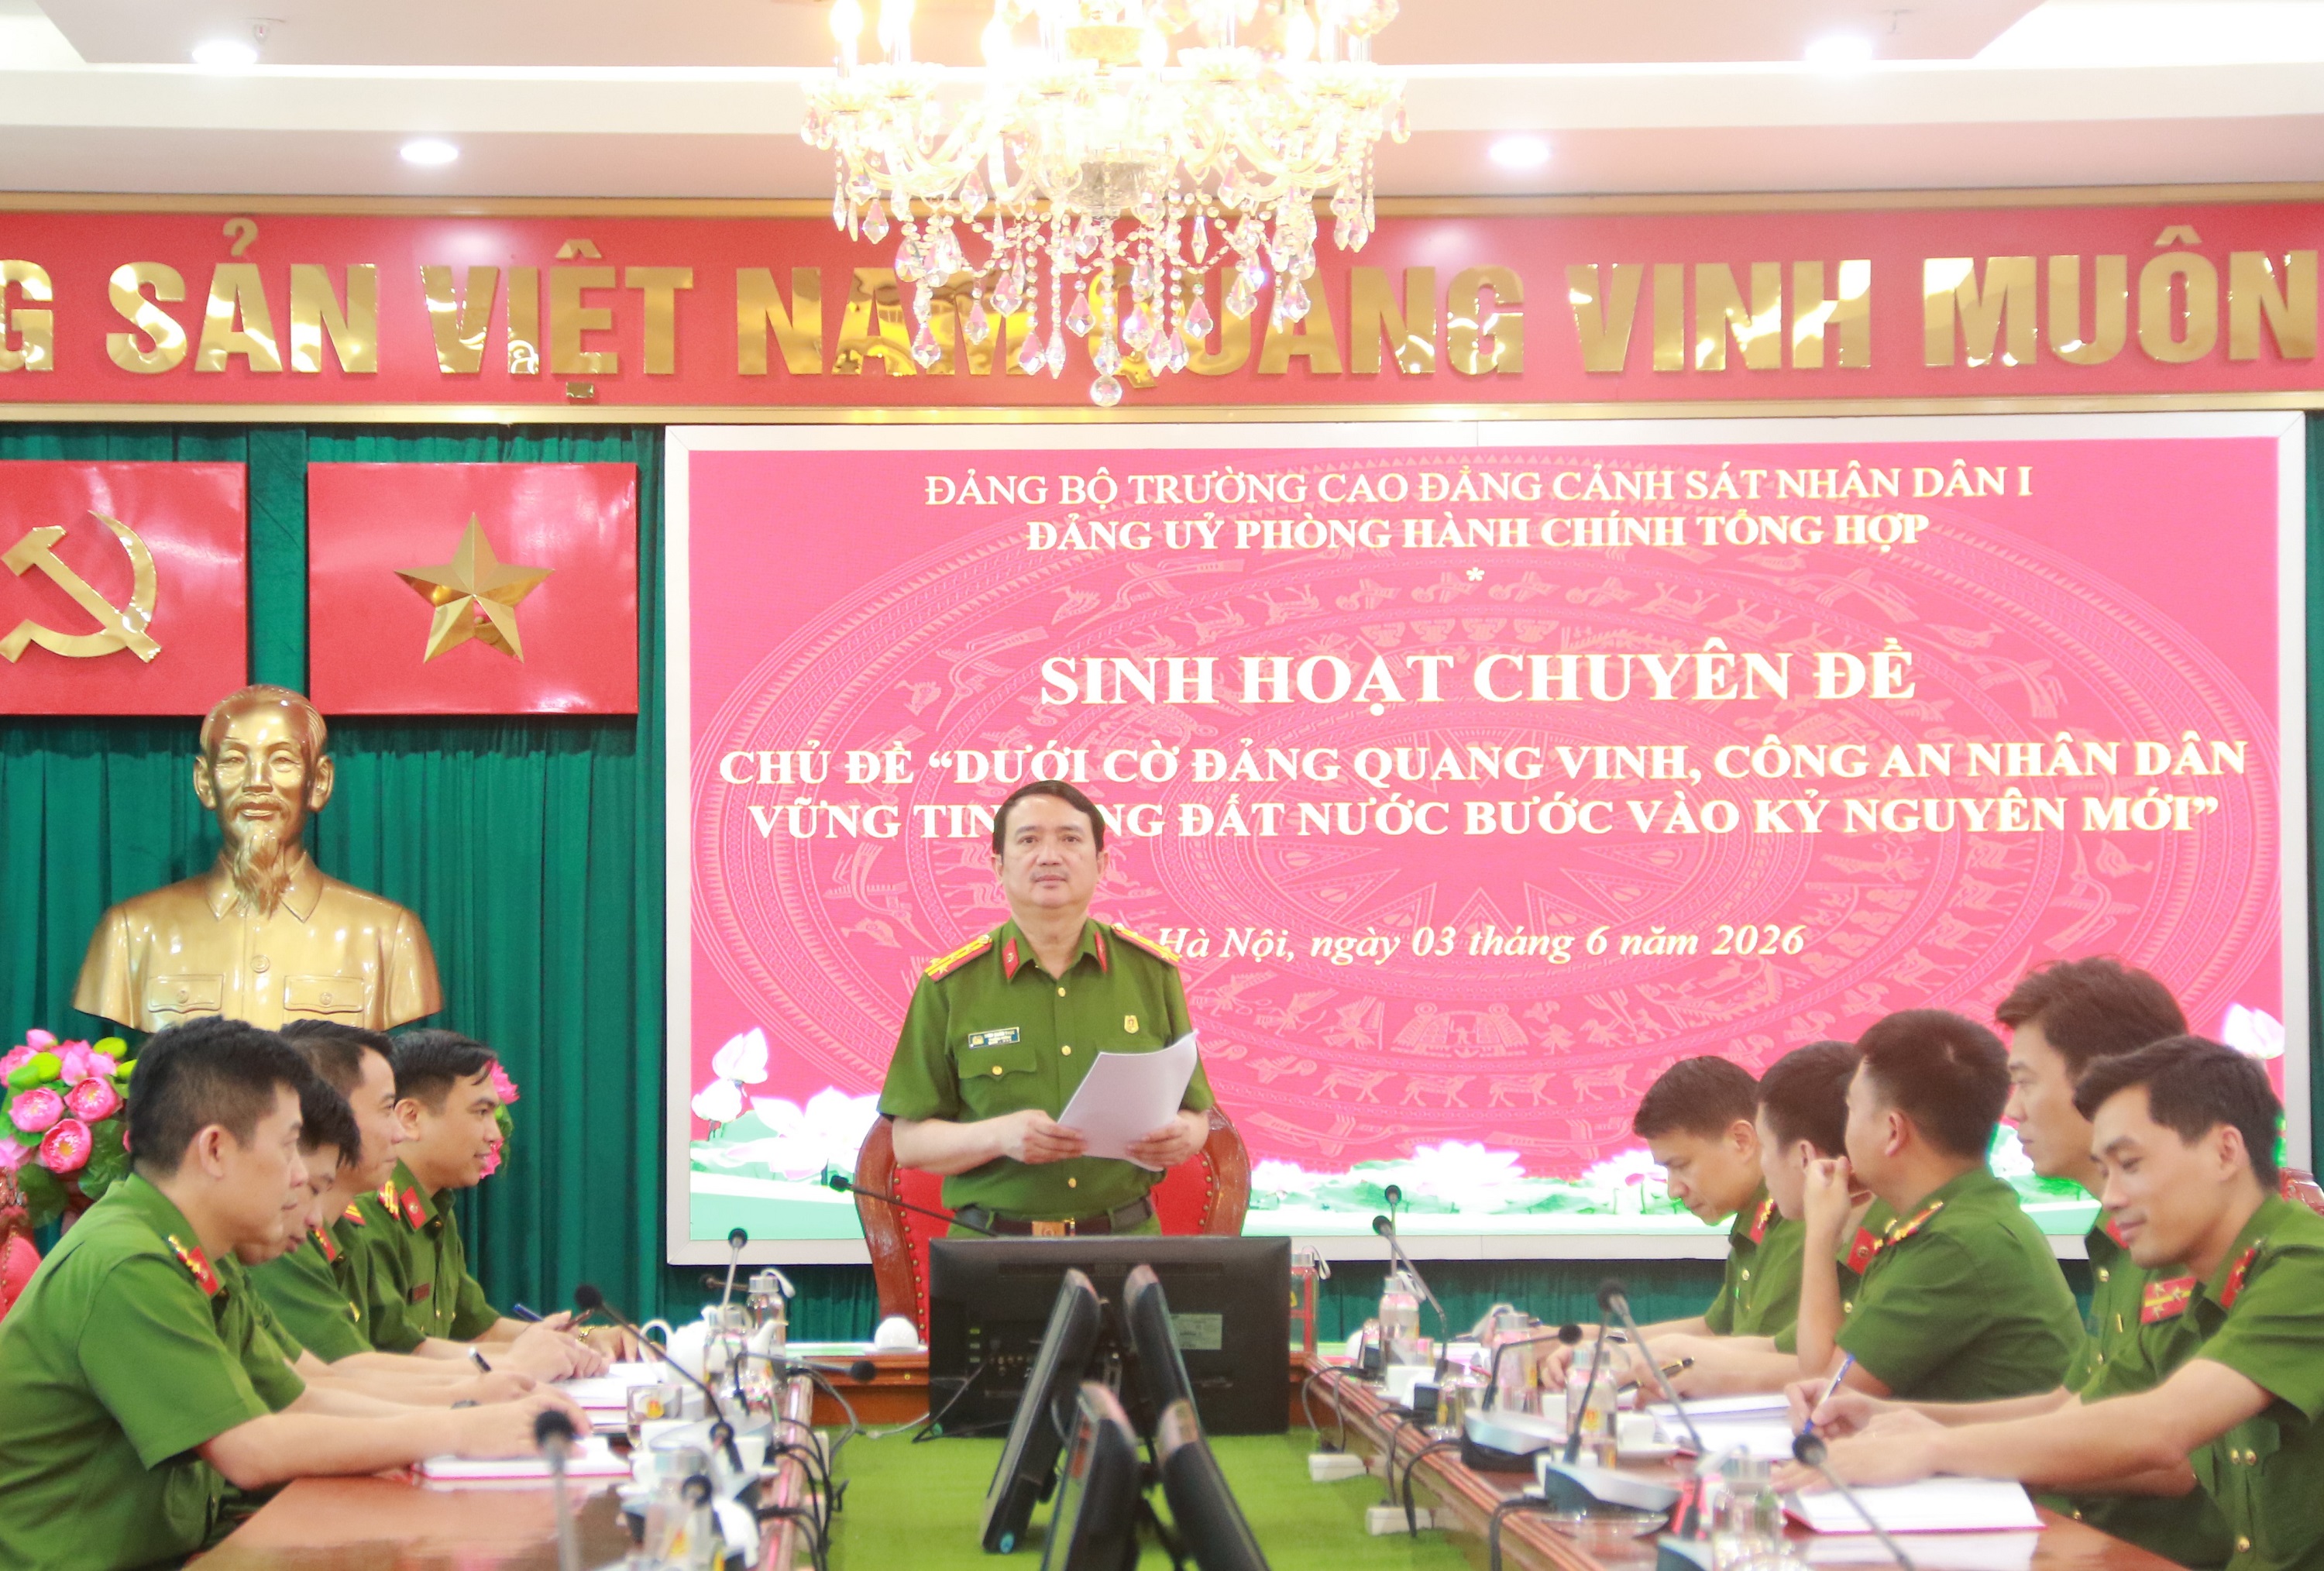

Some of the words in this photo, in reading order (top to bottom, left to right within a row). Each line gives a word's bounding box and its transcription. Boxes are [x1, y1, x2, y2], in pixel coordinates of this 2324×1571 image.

[106, 218, 379, 375] SẢN
[421, 239, 694, 399] VIỆT
[736, 266, 1033, 377] NAM
[1566, 259, 1872, 372] VINH
[1923, 224, 2319, 369] MUÔN
[925, 468, 1049, 505] ĐẢNG
[1058, 466, 1118, 510] BỘ
[1127, 466, 1308, 504] TRƯỜNG
[1318, 473, 1408, 503] CAO
[1418, 465, 1543, 502] ĐẲNG
[1552, 463, 1675, 501] CẢNH
[1686, 461, 1767, 500] SÁT
[1775, 460, 1901, 498] NHÂN
[1913, 459, 2007, 497] DÂN
[2018, 466, 2033, 496] I
[1026, 512, 1152, 551] ĐẢNG
[1163, 511, 1224, 550] UỶ
[1234, 512, 1392, 549] PHÒNG
[1401, 511, 1531, 548] HÀNH
[1540, 510, 1686, 548] CHÍNH
[1834, 512, 1930, 553] HỢP
[1040, 655, 1219, 705] SINH
[1237, 655, 1454, 717] HOẠT
[1473, 637, 1793, 703] CHUYÊN
[1813, 637, 1916, 700] ĐỀ
[720, 740, 830, 784] CHỦ
[844, 741, 913, 783] ĐỀ
[929, 742, 1090, 782] “DƯỚI
[1102, 741, 1180, 782] CỜ
[1191, 737, 1342, 782] ĐẢNG
[1353, 747, 1544, 789] QUANG
[1556, 745, 1702, 785] VINH,
[1714, 734, 1869, 779] CÔNG
[1879, 742, 1954, 777] AN
[1966, 731, 2120, 776] NHÂN
[2133, 730, 2248, 775] DÂN
[748, 797, 901, 839] VỮNG
[1177, 792, 1285, 837] ĐẤT
[1297, 792, 1449, 837] NƯỚC
[1463, 792, 1613, 835] BƯỚC
[1627, 791, 1740, 834] VÀO
[1753, 787, 1830, 833] KỶ
[1843, 787, 2068, 832] NGUYÊN
[2082, 786, 2219, 831] MỚI”
[1159, 927, 1209, 958] Hà
[1219, 927, 1294, 962] Nội,
[1310, 927, 1401, 965] ngày
[1412, 926, 1456, 956] 03
[1469, 925, 1576, 964] tháng
[1586, 925, 1611, 955] 6
[1620, 926, 1700, 955] năm
[1710, 924, 1807, 955] 2026
